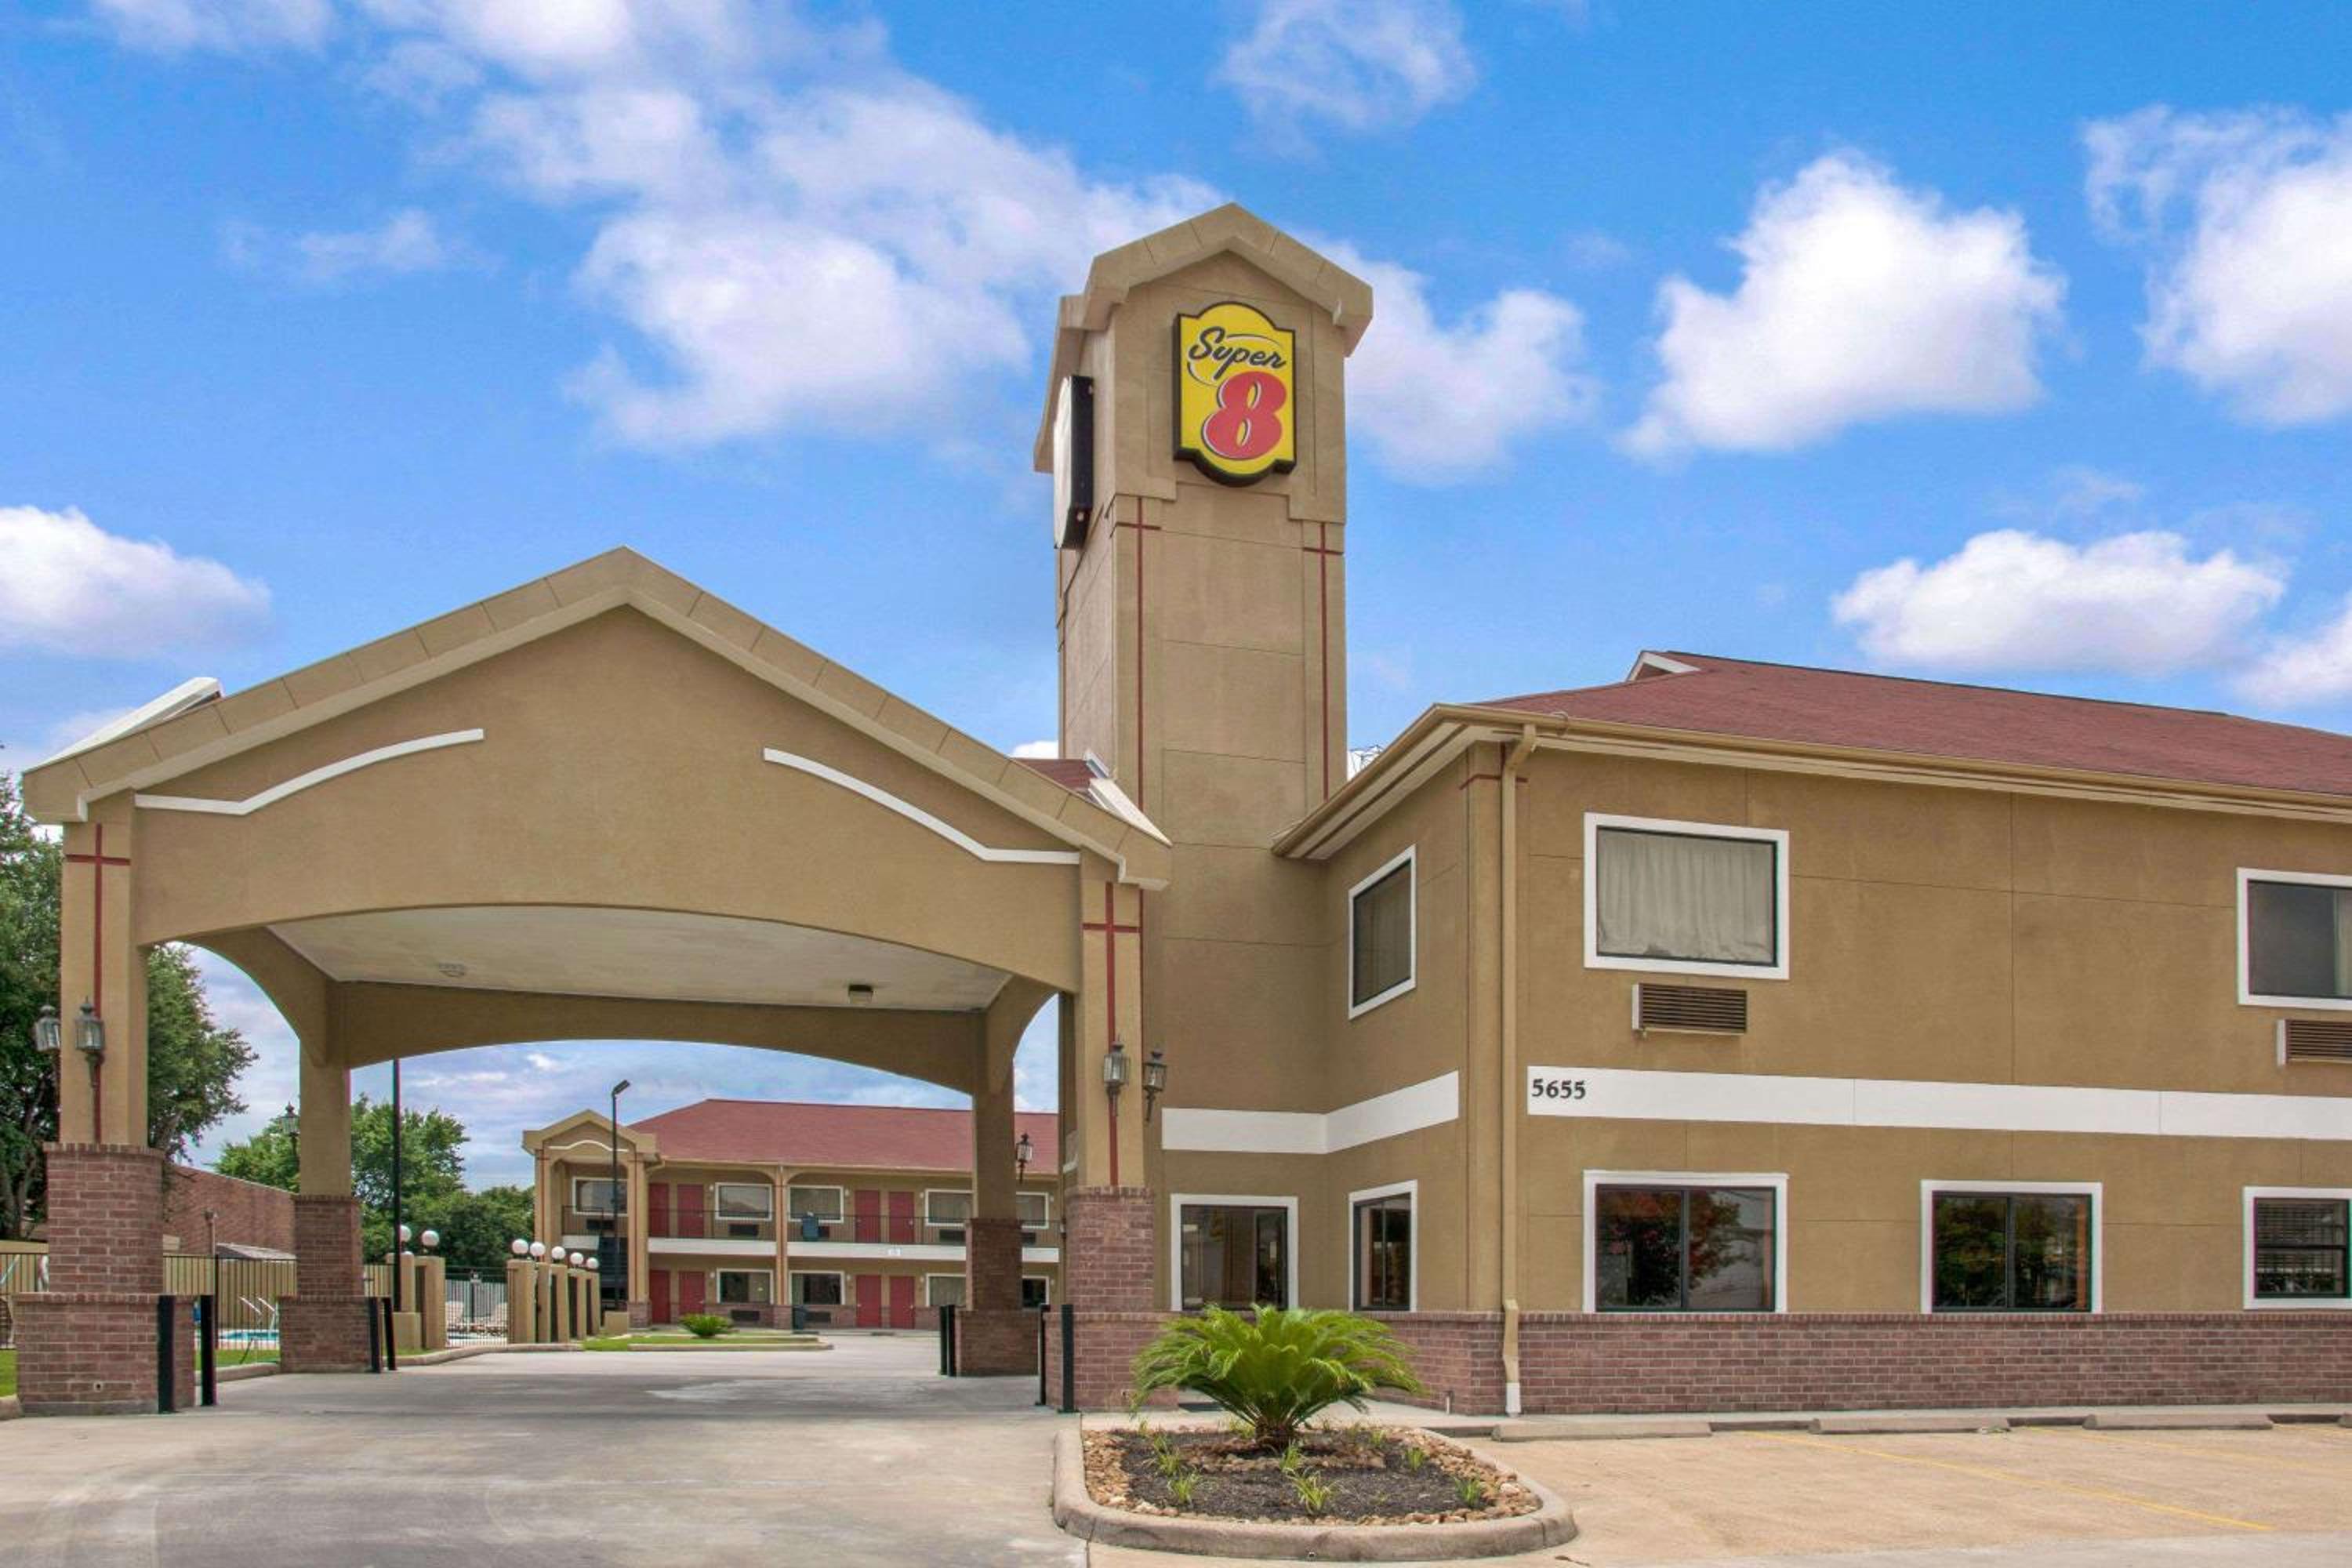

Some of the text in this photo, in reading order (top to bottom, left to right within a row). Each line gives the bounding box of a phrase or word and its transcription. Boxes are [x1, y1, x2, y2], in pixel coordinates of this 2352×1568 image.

[1189, 326, 1286, 380] Super
[1201, 371, 1287, 461] 8
[1531, 1078, 1586, 1100] 5655
